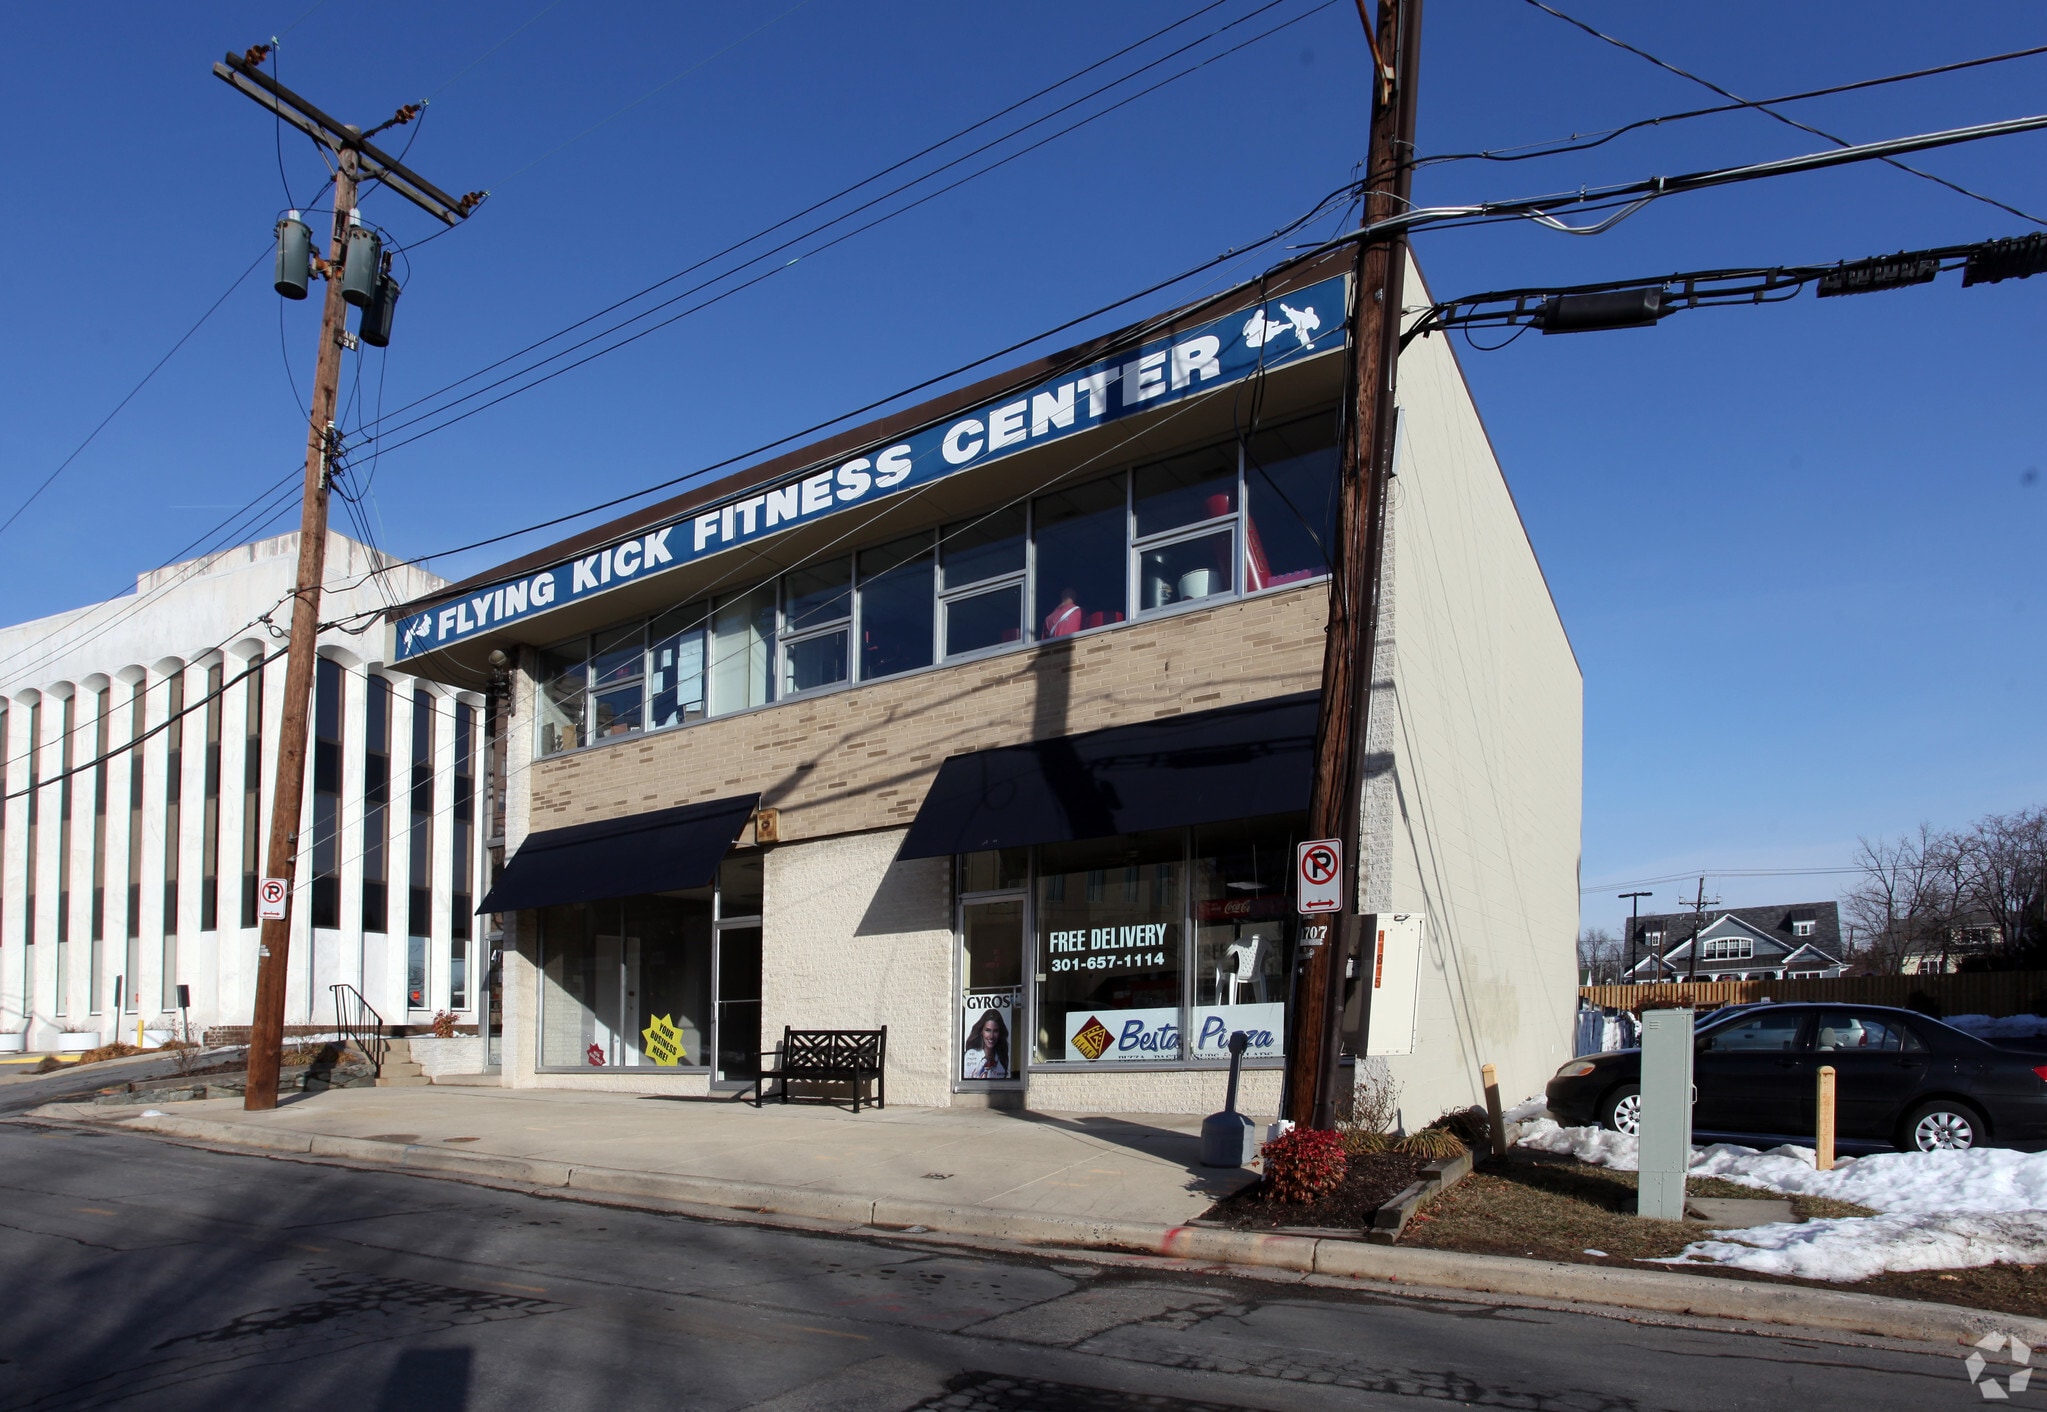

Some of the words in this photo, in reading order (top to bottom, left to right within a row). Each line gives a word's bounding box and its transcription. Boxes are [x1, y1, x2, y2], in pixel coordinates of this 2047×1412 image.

[438, 572, 555, 641] FLYING
[572, 525, 672, 595] KICK
[694, 444, 912, 551] FITNESS
[941, 335, 1221, 465] CENTER
[1050, 930, 1086, 953] FREE
[1091, 923, 1167, 950] DELIVERY
[1302, 925, 1328, 939] 707
[1051, 952, 1165, 972] 301-657-1114
[967, 995, 1011, 1009] GYROS
[659, 1022, 674, 1040] YOUR
[1118, 1019, 1181, 1052] Besta
[1198, 1016, 1275, 1050] Piza
[650, 1030, 678, 1055] BUSINESS
[652, 1045, 669, 1062] HERE!
